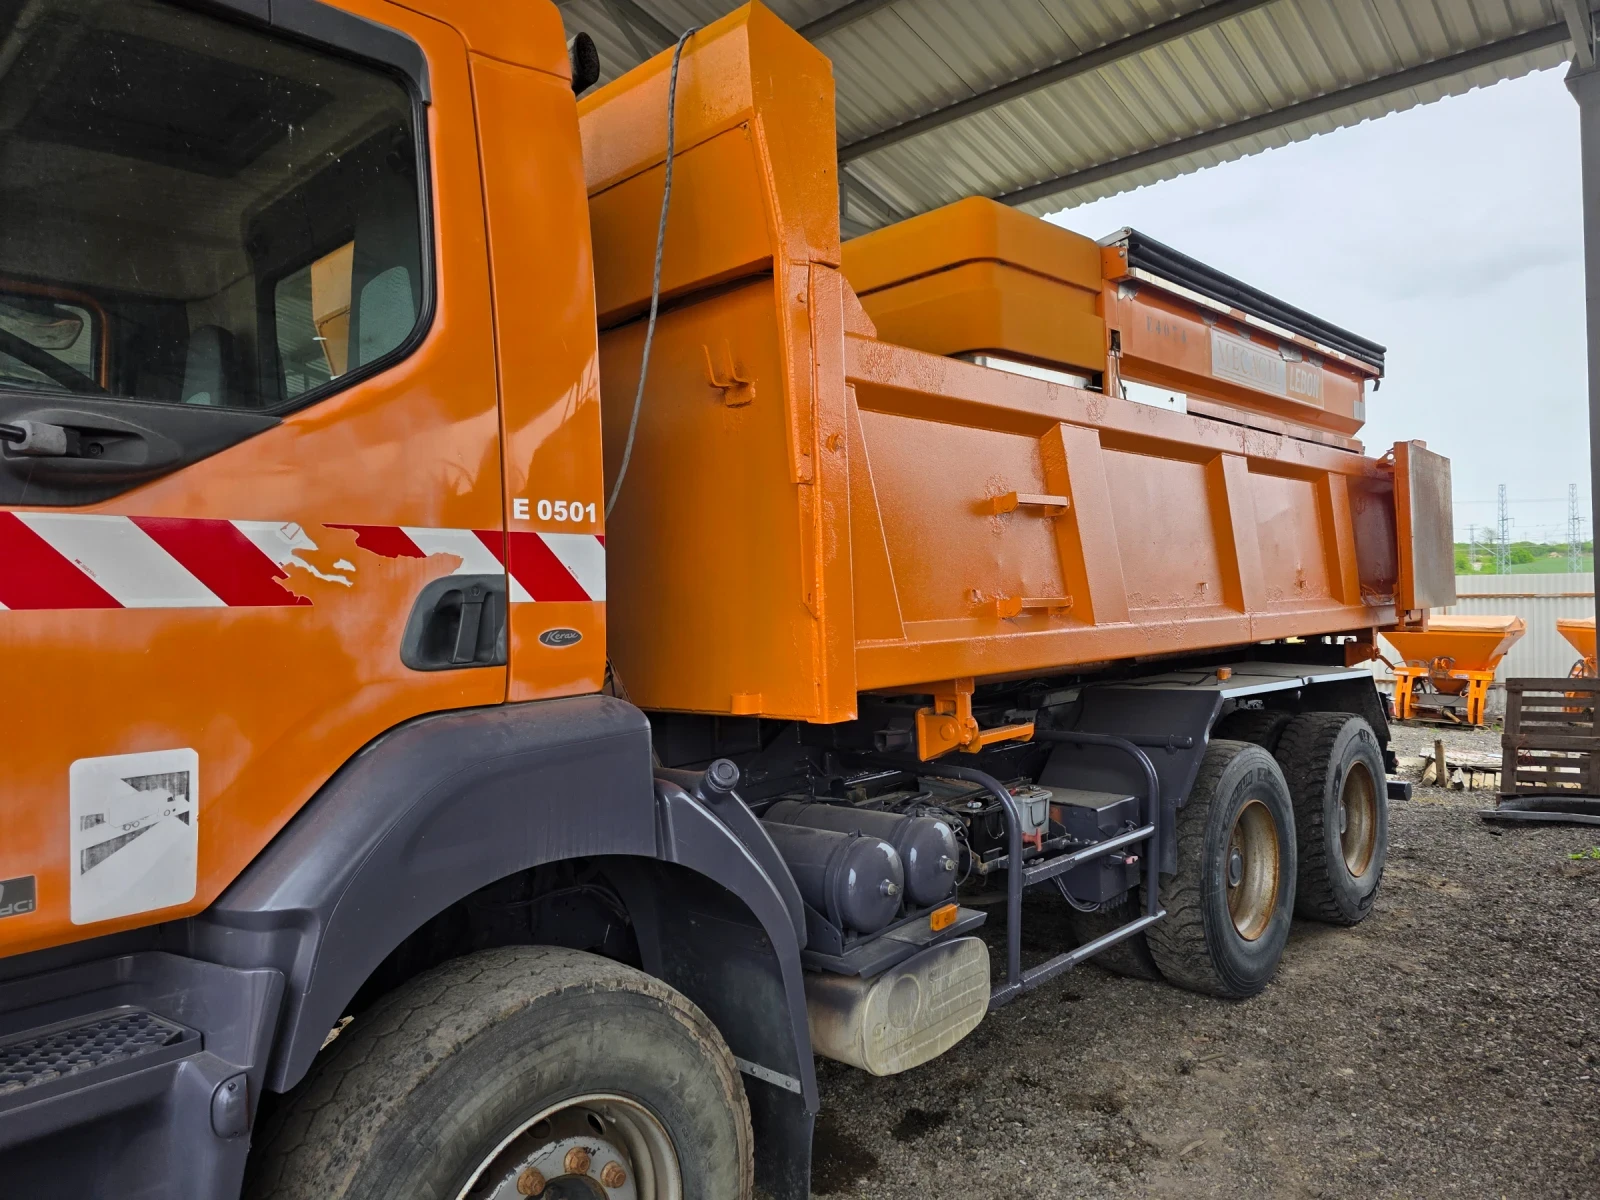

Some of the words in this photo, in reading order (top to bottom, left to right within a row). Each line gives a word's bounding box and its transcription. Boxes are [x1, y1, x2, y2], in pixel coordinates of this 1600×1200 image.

[1290, 366, 1320, 399] LEBON
[513, 498, 530, 520] E
[537, 499, 596, 523] 0501
[544, 631, 579, 643] Kerax
